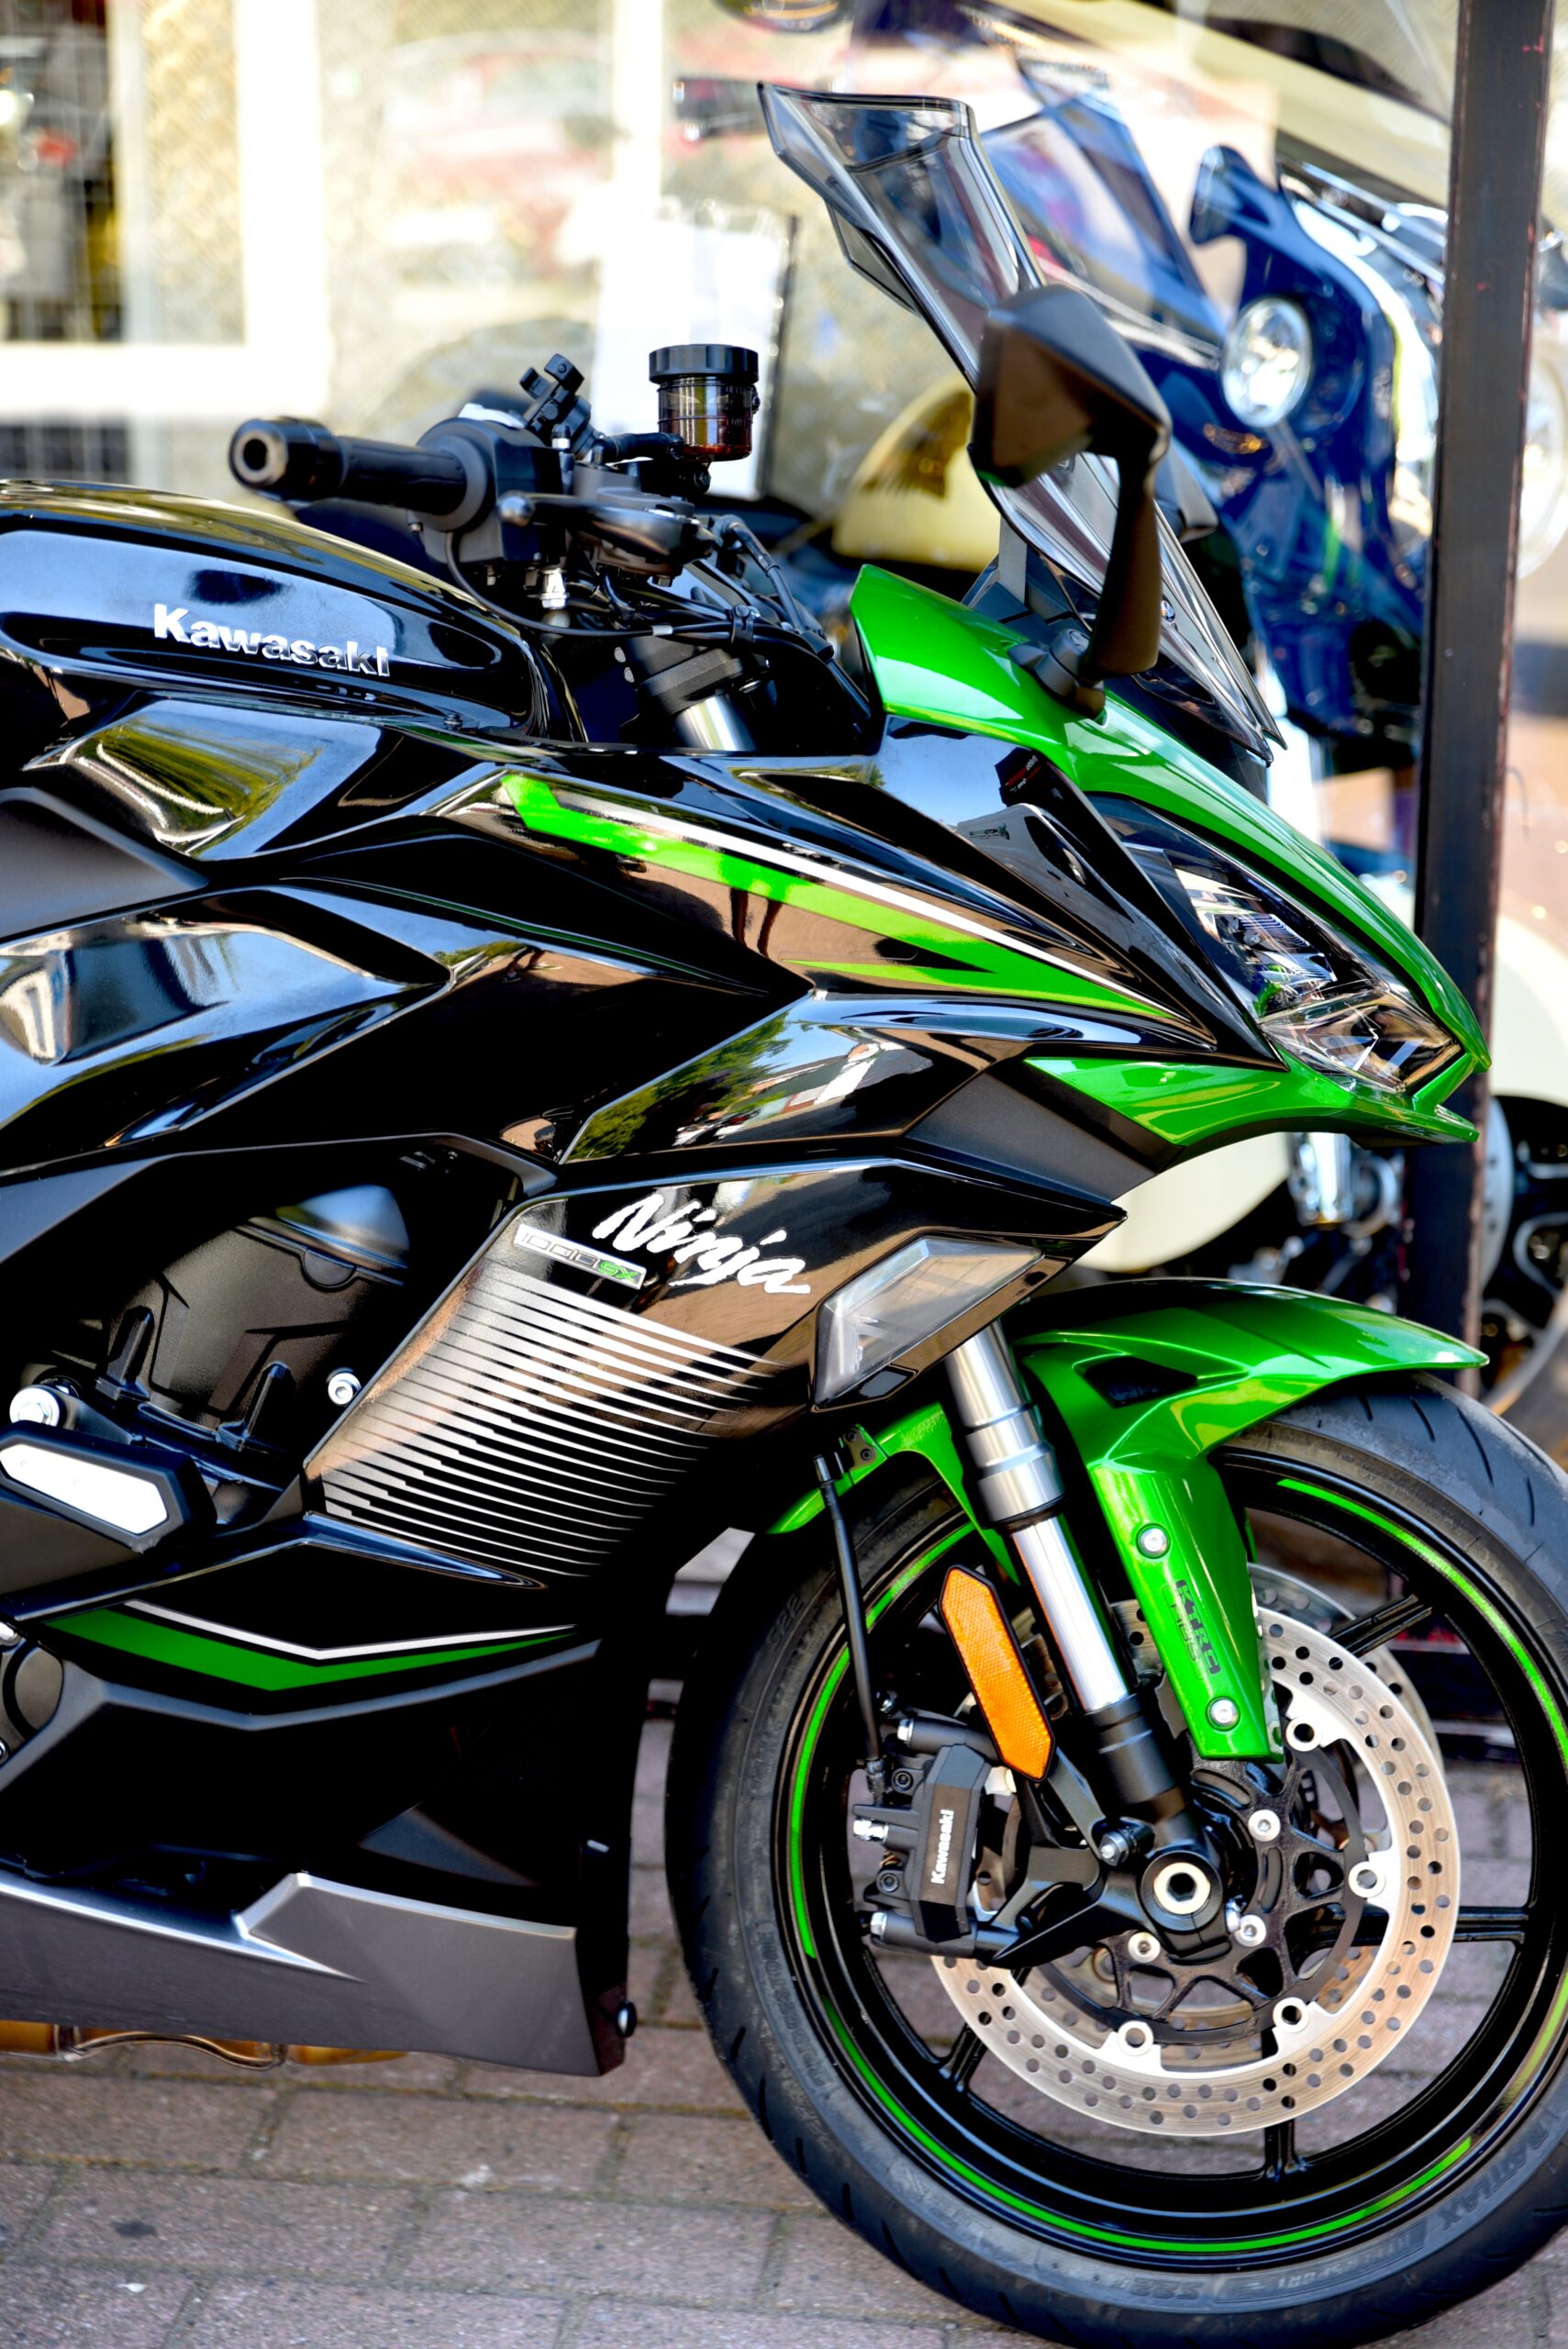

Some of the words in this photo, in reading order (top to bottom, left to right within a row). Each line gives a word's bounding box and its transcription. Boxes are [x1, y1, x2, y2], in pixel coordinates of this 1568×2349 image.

[153, 603, 390, 677] Kawasaki
[592, 1194, 811, 1295] Ninja
[1176, 1585, 1218, 1668] KTRC
[930, 1809, 954, 1884] Kawasaki
